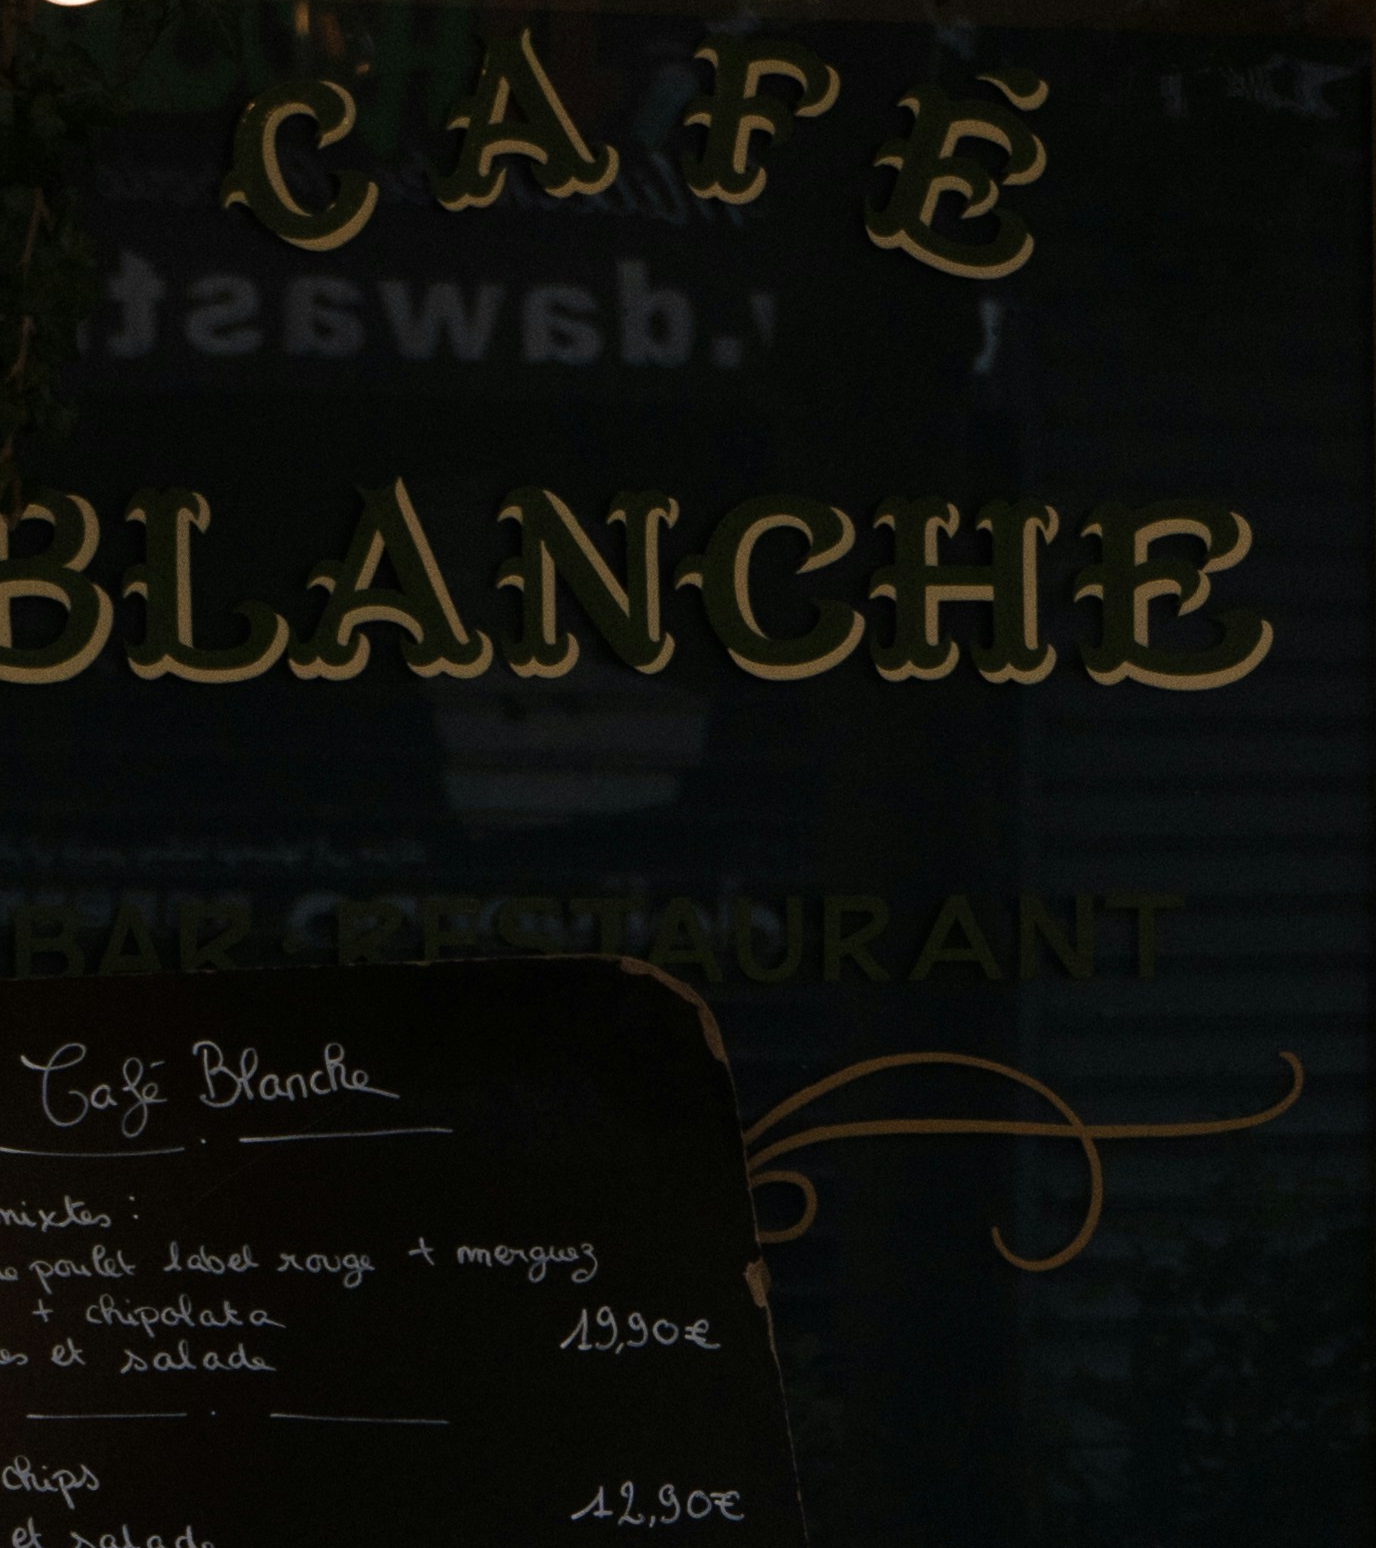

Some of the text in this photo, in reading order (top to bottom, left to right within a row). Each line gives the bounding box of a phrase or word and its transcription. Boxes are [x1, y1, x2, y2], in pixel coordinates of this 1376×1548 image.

[224, 26, 1054, 282] CAFÉ
[19, 1039, 400, 1139] Café Blanche
[28, 1243, 136, 1295] poulet
[163, 1241, 259, 1275] label
[276, 1252, 376, 1289] rouge
[455, 1242, 599, 1284] merguez
[85, 1294, 285, 1338] chipolata
[558, 1304, 721, 1355] 19,90€
[50, 1337, 86, 1367] et
[119, 1339, 276, 1375] salade
[0, 1456, 100, 1510] chips
[569, 1479, 745, 1529] 12,90€
